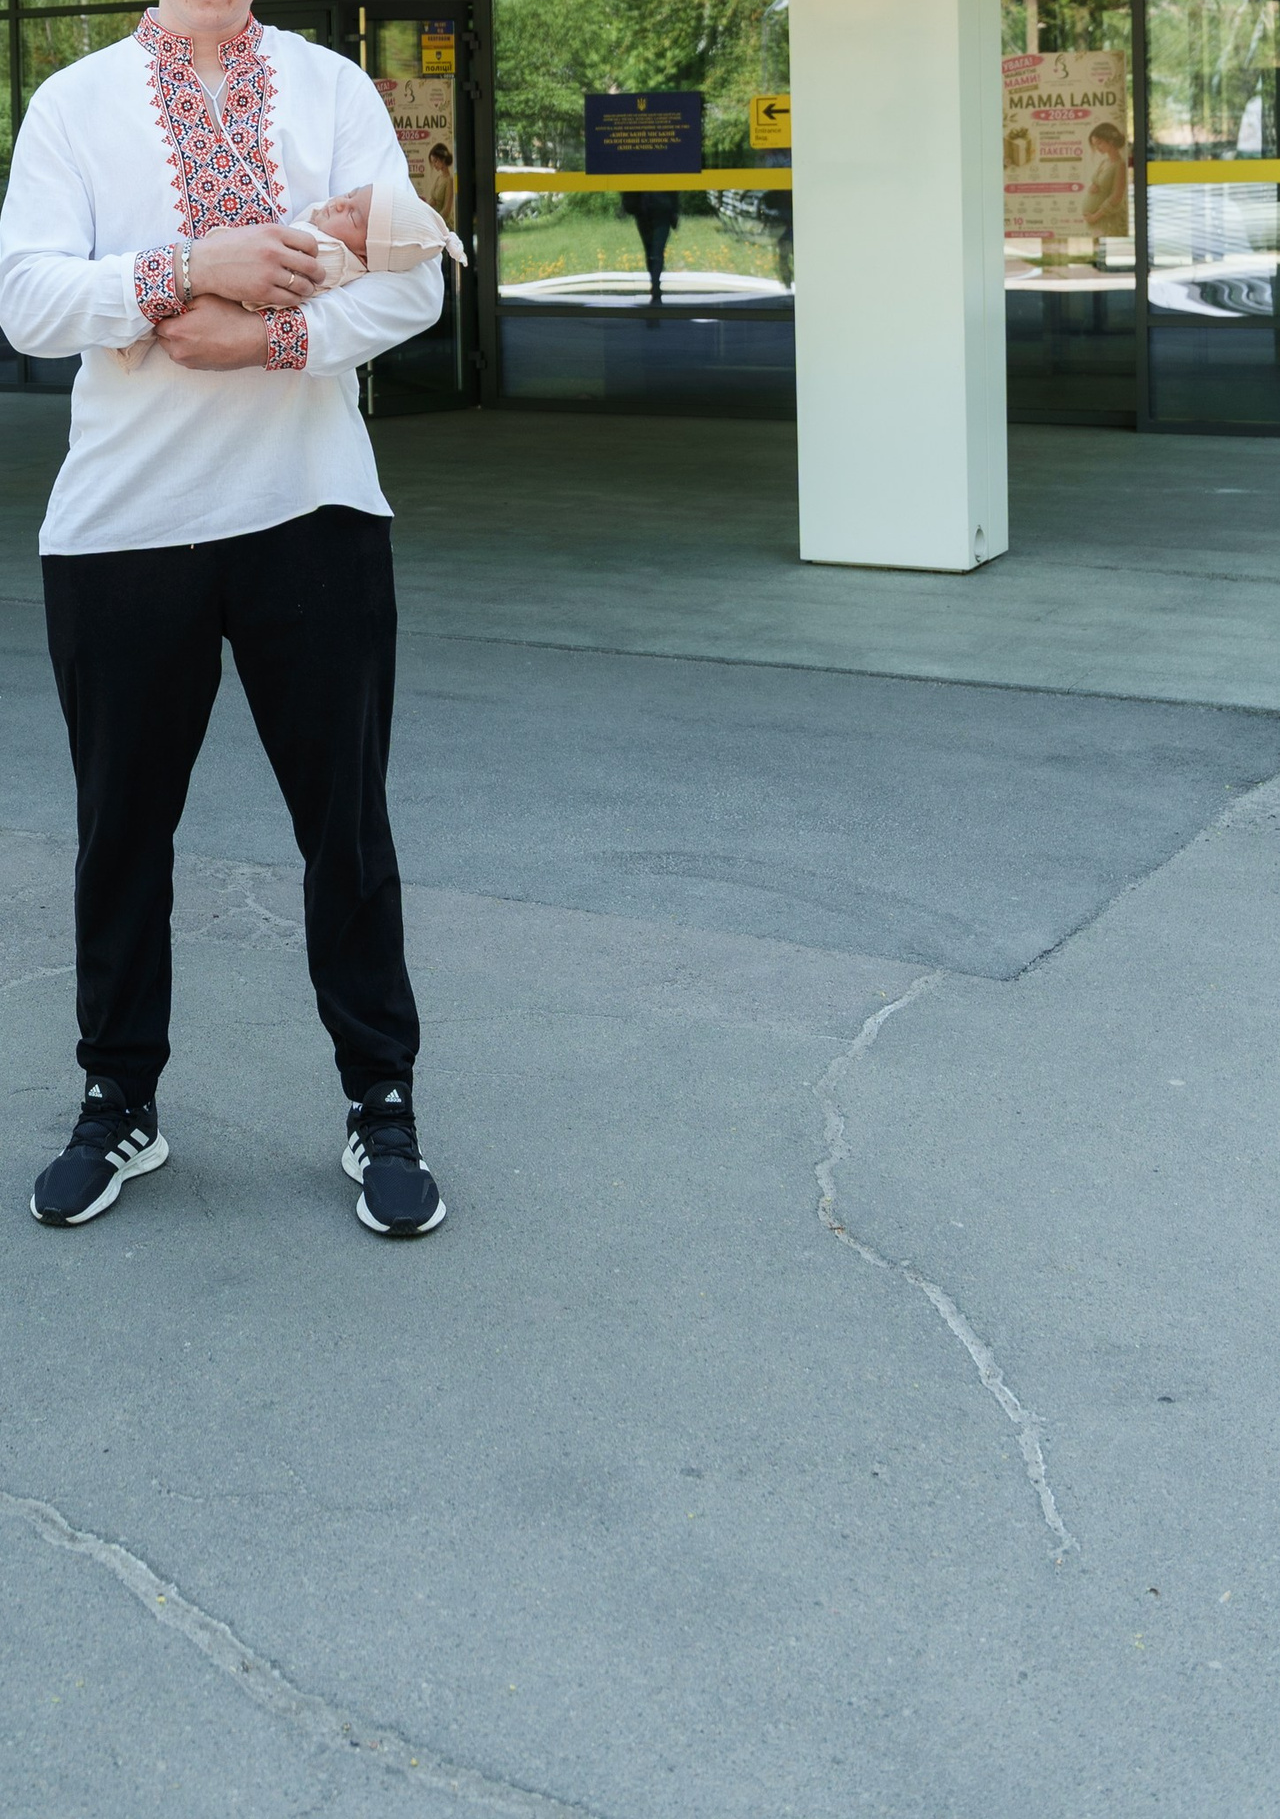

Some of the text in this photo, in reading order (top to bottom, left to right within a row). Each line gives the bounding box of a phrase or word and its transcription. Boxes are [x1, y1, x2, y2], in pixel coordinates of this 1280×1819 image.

[1008, 91, 1117, 110] MAMA LAND
[1047, 110, 1076, 120] 2026
[393, 115, 447, 129] MA LAND
[400, 131, 420, 140] 2026
[1039, 146, 1074, 156] ПАКЕТ!
